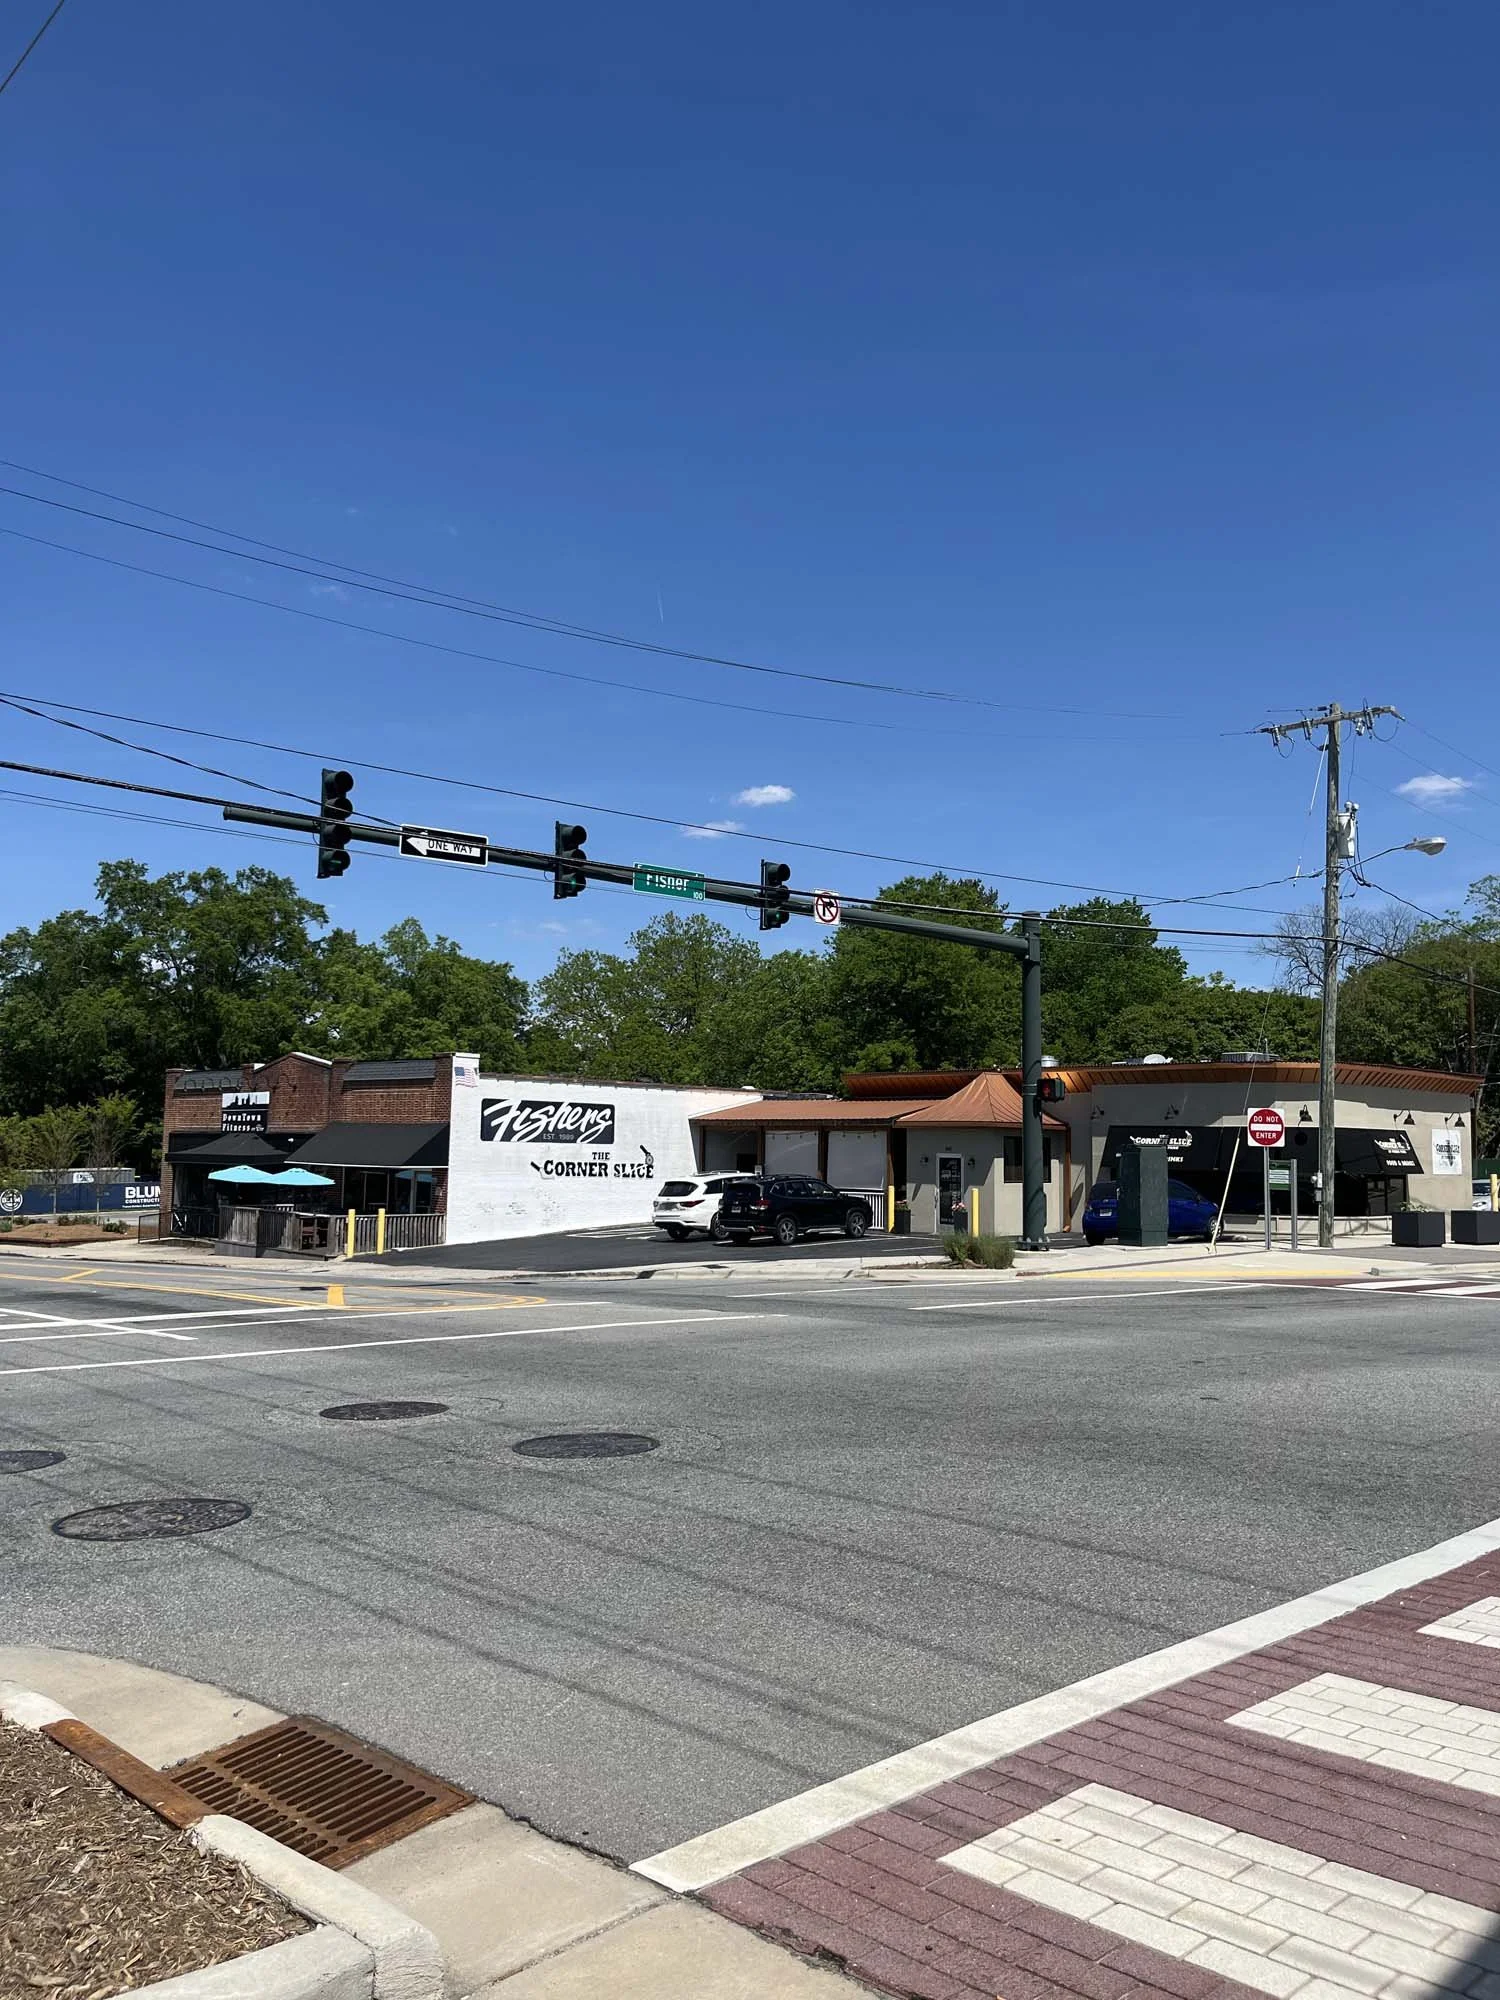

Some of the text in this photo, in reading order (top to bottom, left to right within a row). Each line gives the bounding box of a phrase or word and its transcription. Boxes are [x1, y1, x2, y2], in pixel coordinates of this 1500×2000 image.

[428, 840, 473, 855] ONE WAY
[693, 891, 703, 900] 100
[483, 1100, 613, 1143] Fishers
[1253, 1115, 1263, 1123] DO
[592, 1152, 611, 1160] THE
[543, 1160, 654, 1179] CORNER SLICE
